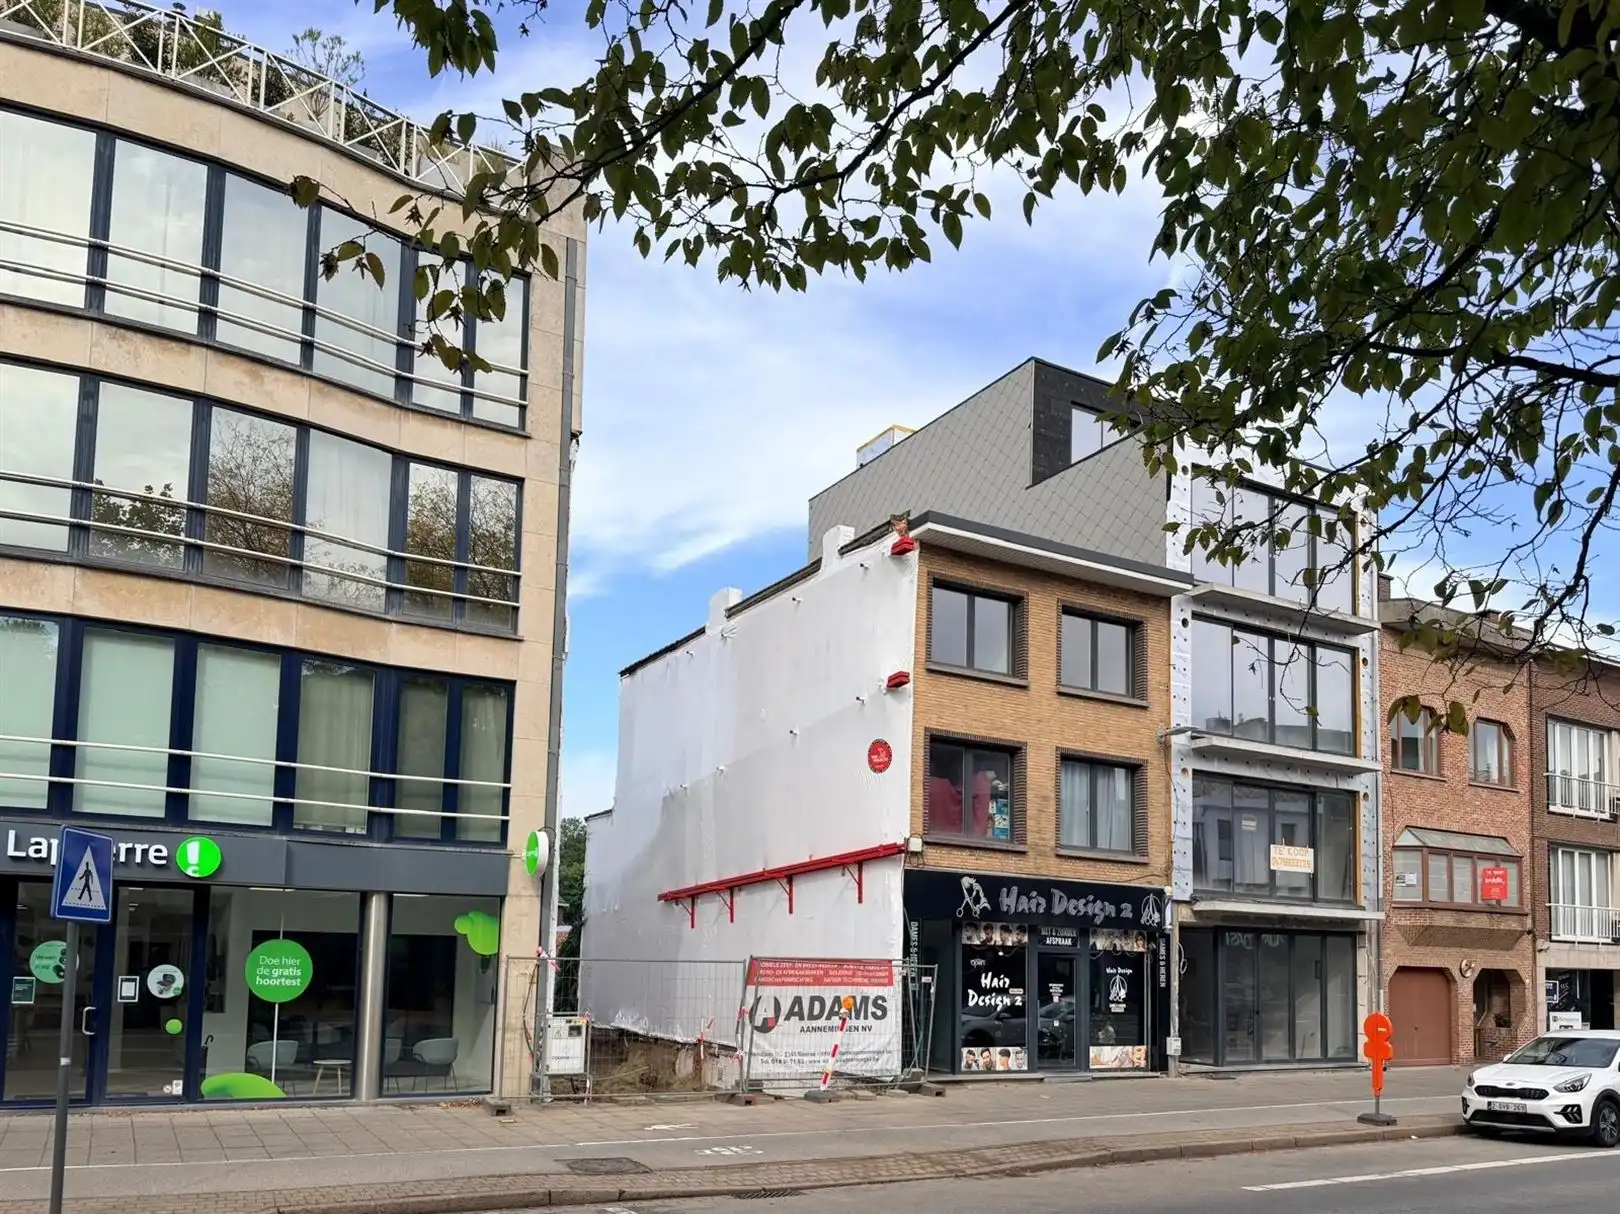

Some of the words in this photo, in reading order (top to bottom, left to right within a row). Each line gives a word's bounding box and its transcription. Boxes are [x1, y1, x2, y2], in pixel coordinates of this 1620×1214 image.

[6, 829, 168, 865] Larre
[999, 885, 1046, 915] Hair
[1051, 887, 1116, 925] Design
[1120, 902, 1133, 918] 2
[1046, 937, 1072, 946] AFSPRAAK
[1158, 938, 1166, 960] DAMES
[259, 955, 280, 965] Doe
[282, 955, 301, 965] hier
[256, 976, 301, 987] hoortest
[257, 967, 270, 976] de
[272, 967, 301, 978] gratis
[980, 971, 1010, 990] Hair
[784, 995, 888, 1021] ADAMS
[967, 989, 1010, 1012] Design
[1014, 996, 1023, 1006] 2
[861, 1025, 873, 1034] NV
